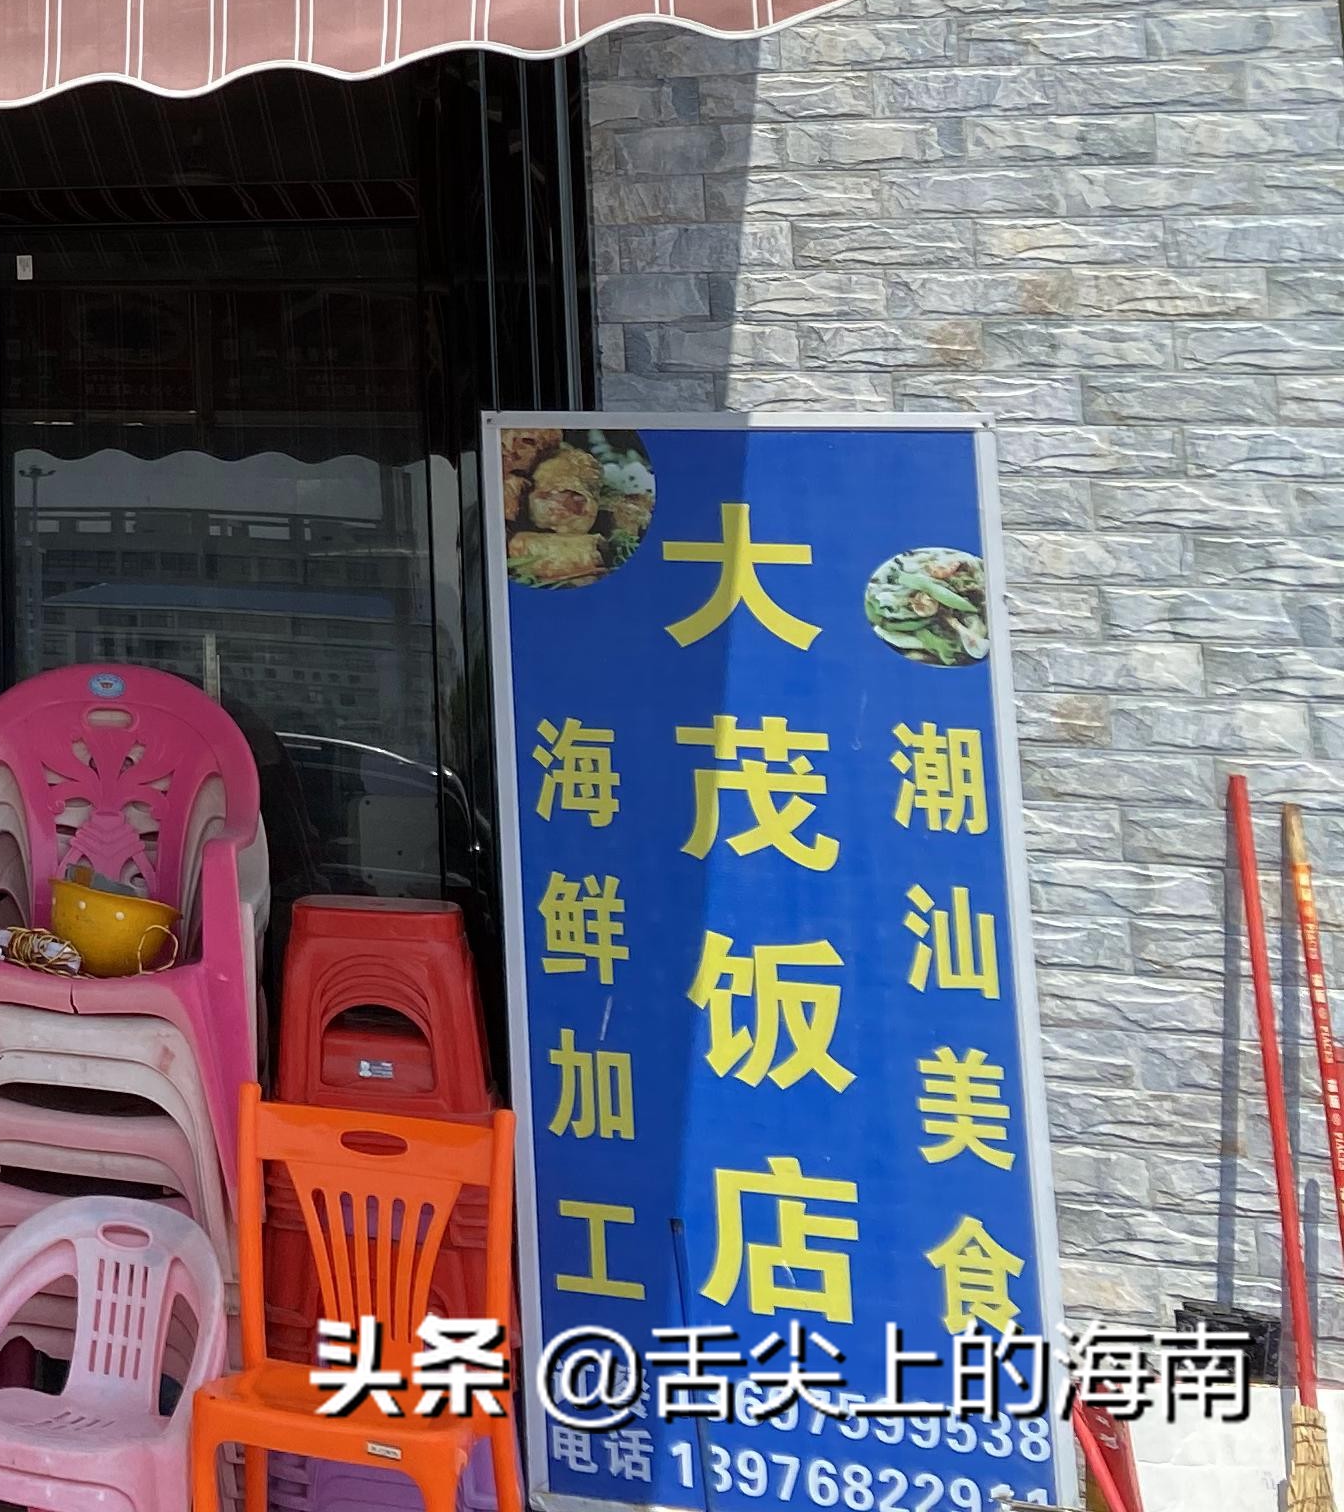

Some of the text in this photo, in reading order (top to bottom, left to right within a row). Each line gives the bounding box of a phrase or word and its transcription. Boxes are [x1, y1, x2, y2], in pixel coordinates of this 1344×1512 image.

[532, 717, 646, 1301] 海鲜加工
[661, 502, 858, 1325] 大茂饭店
[889, 722, 1025, 1336] 潮汕美食
[552, 1425, 655, 1483] 电话
